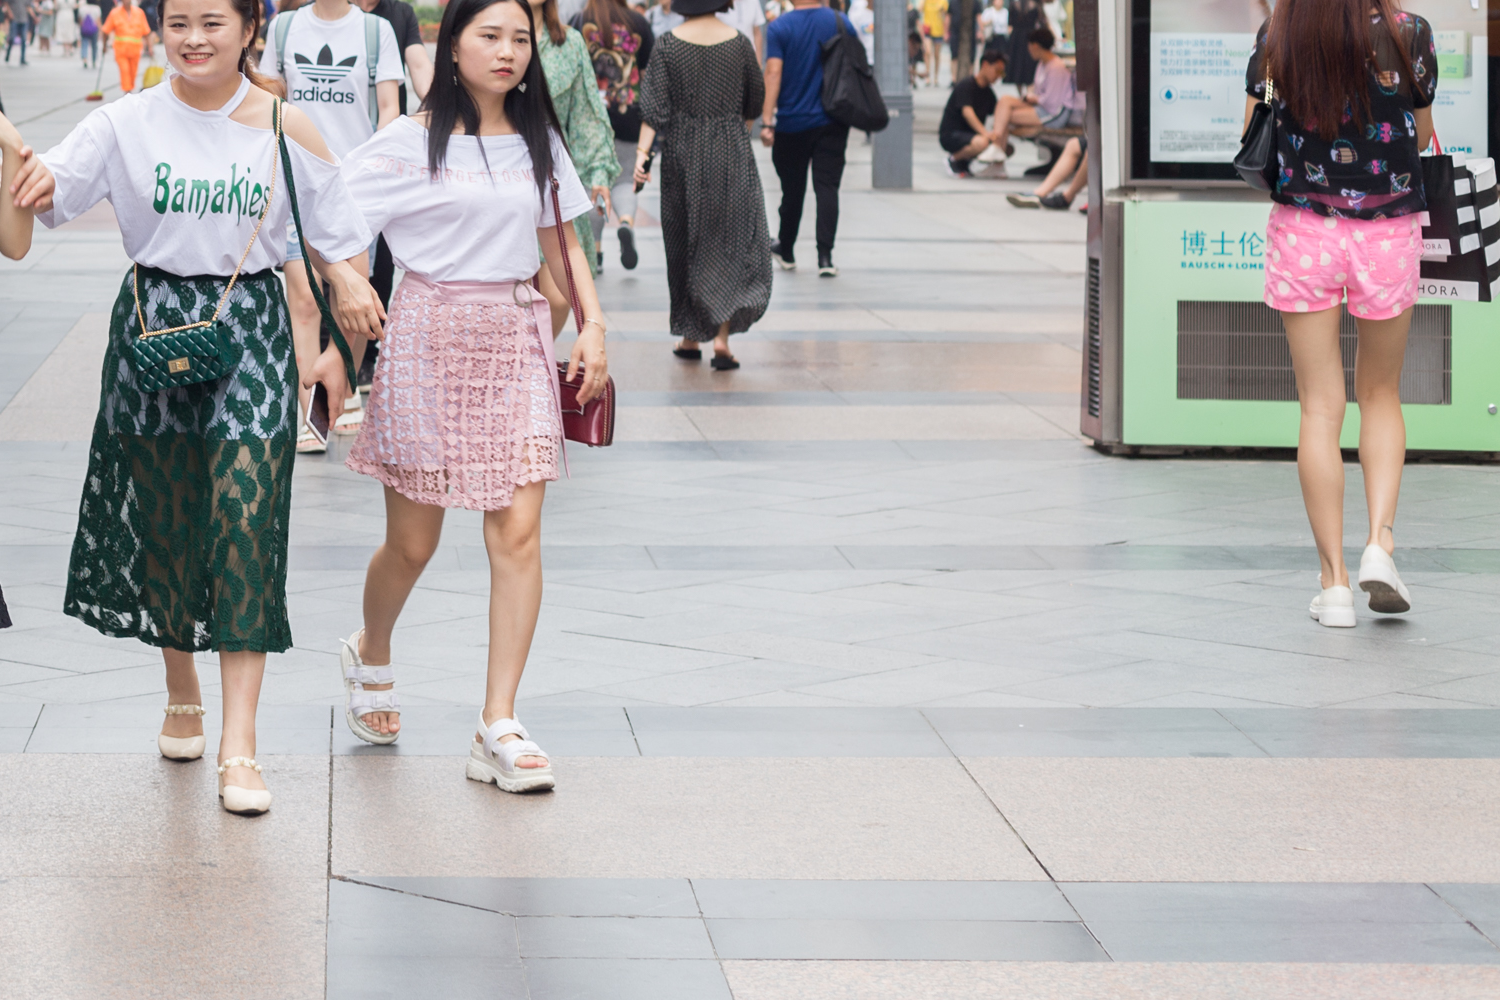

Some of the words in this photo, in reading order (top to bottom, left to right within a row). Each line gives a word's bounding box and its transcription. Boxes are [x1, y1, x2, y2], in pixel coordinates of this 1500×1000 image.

[293, 86, 355, 104] adidas
[153, 162, 271, 226] Bamakies
[1180, 229, 1264, 257] 博士伦
